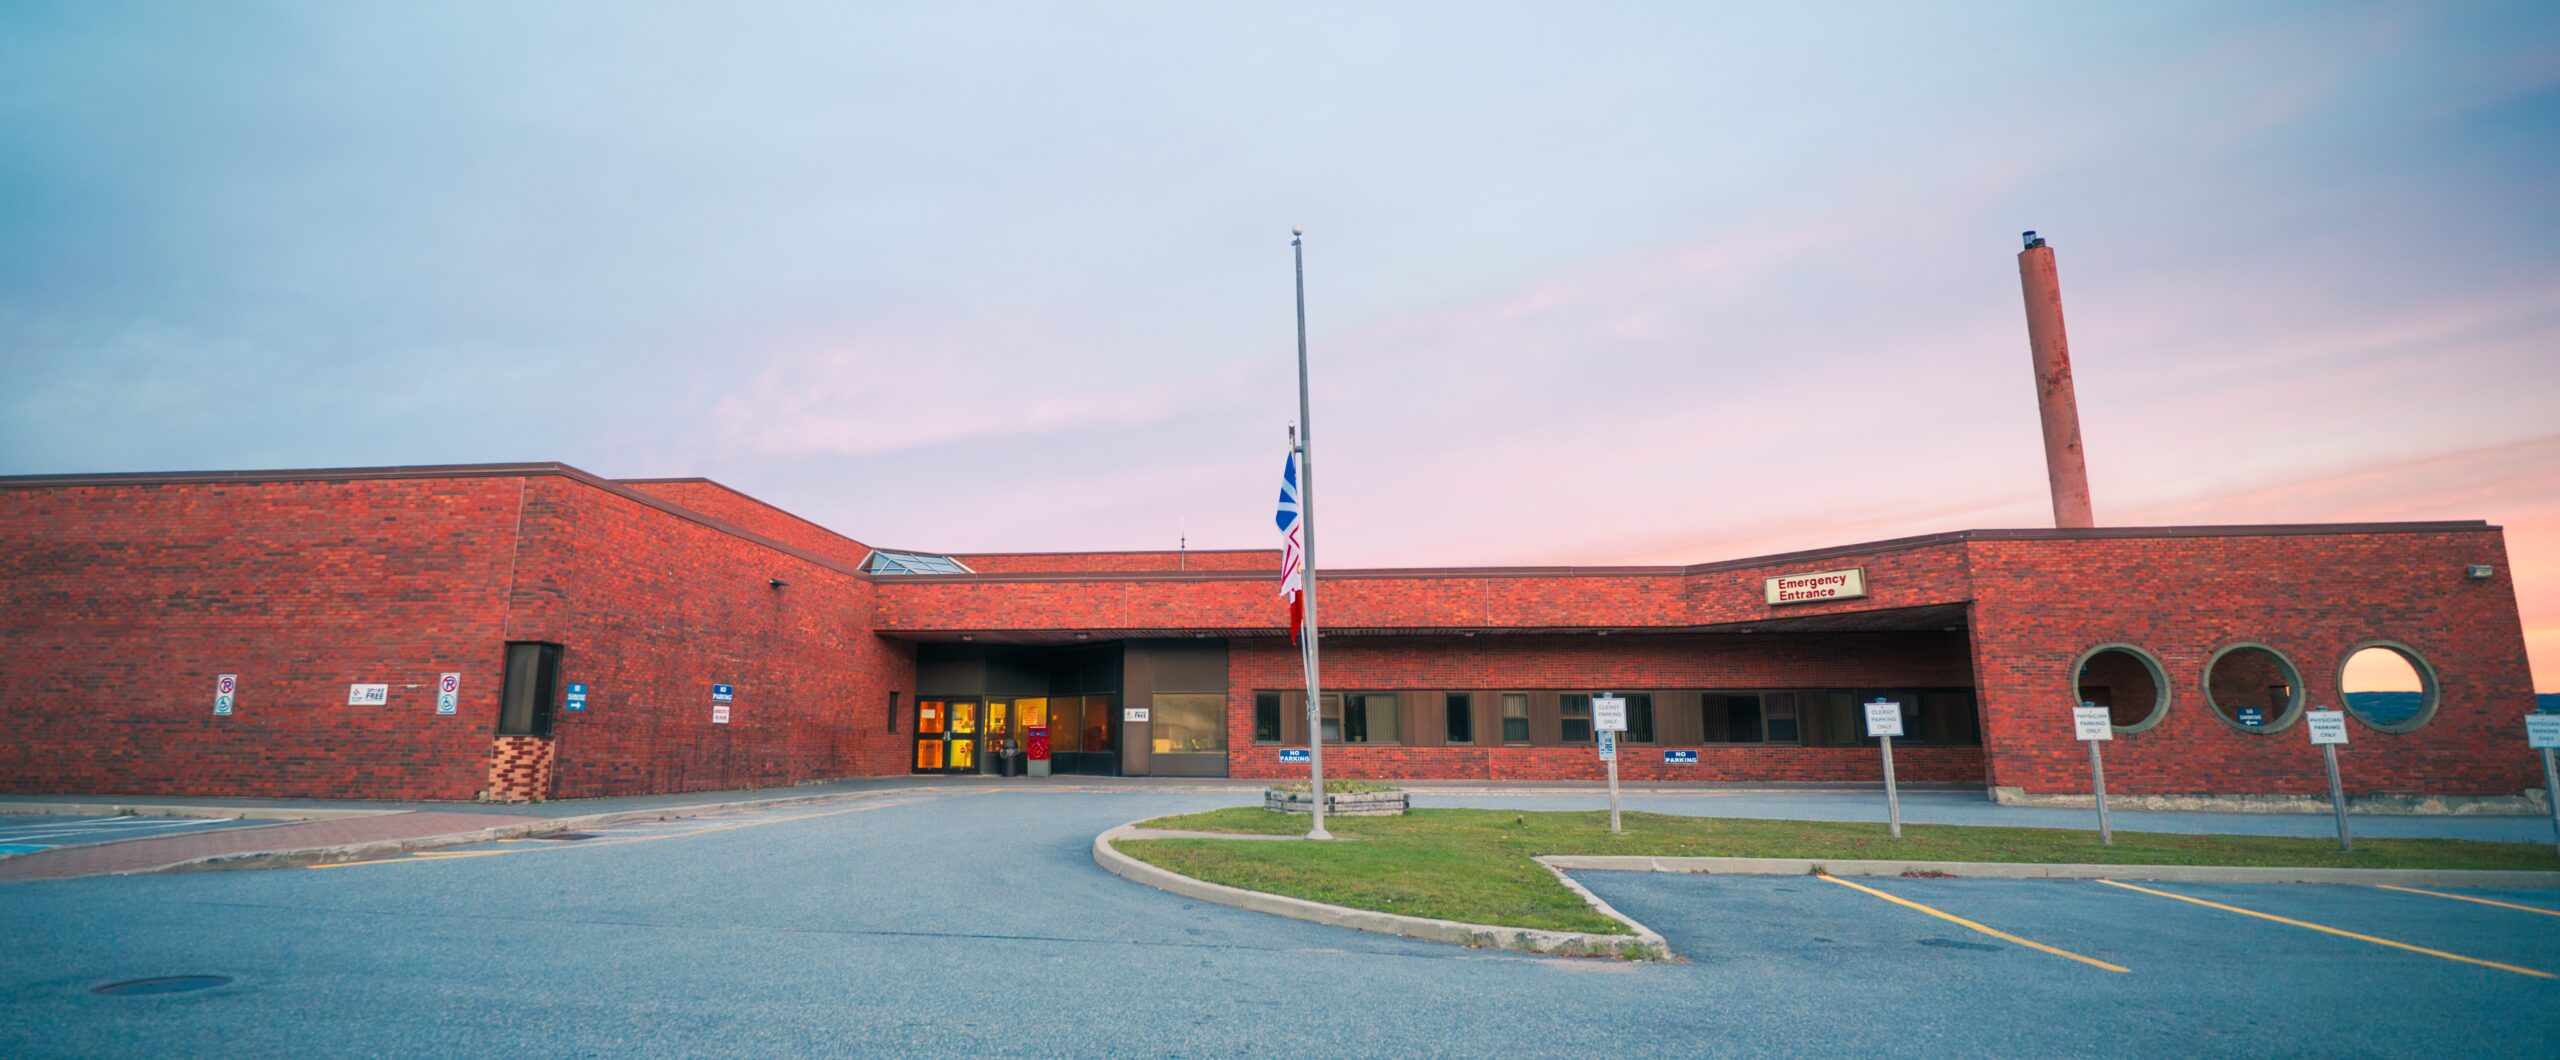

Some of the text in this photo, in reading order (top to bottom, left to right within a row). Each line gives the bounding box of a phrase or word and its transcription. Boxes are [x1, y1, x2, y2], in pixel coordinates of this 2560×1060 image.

[1778, 575, 1846, 589] Emergency
[1779, 588, 1835, 600] Entrance
[713, 693, 733, 701] PARKING
